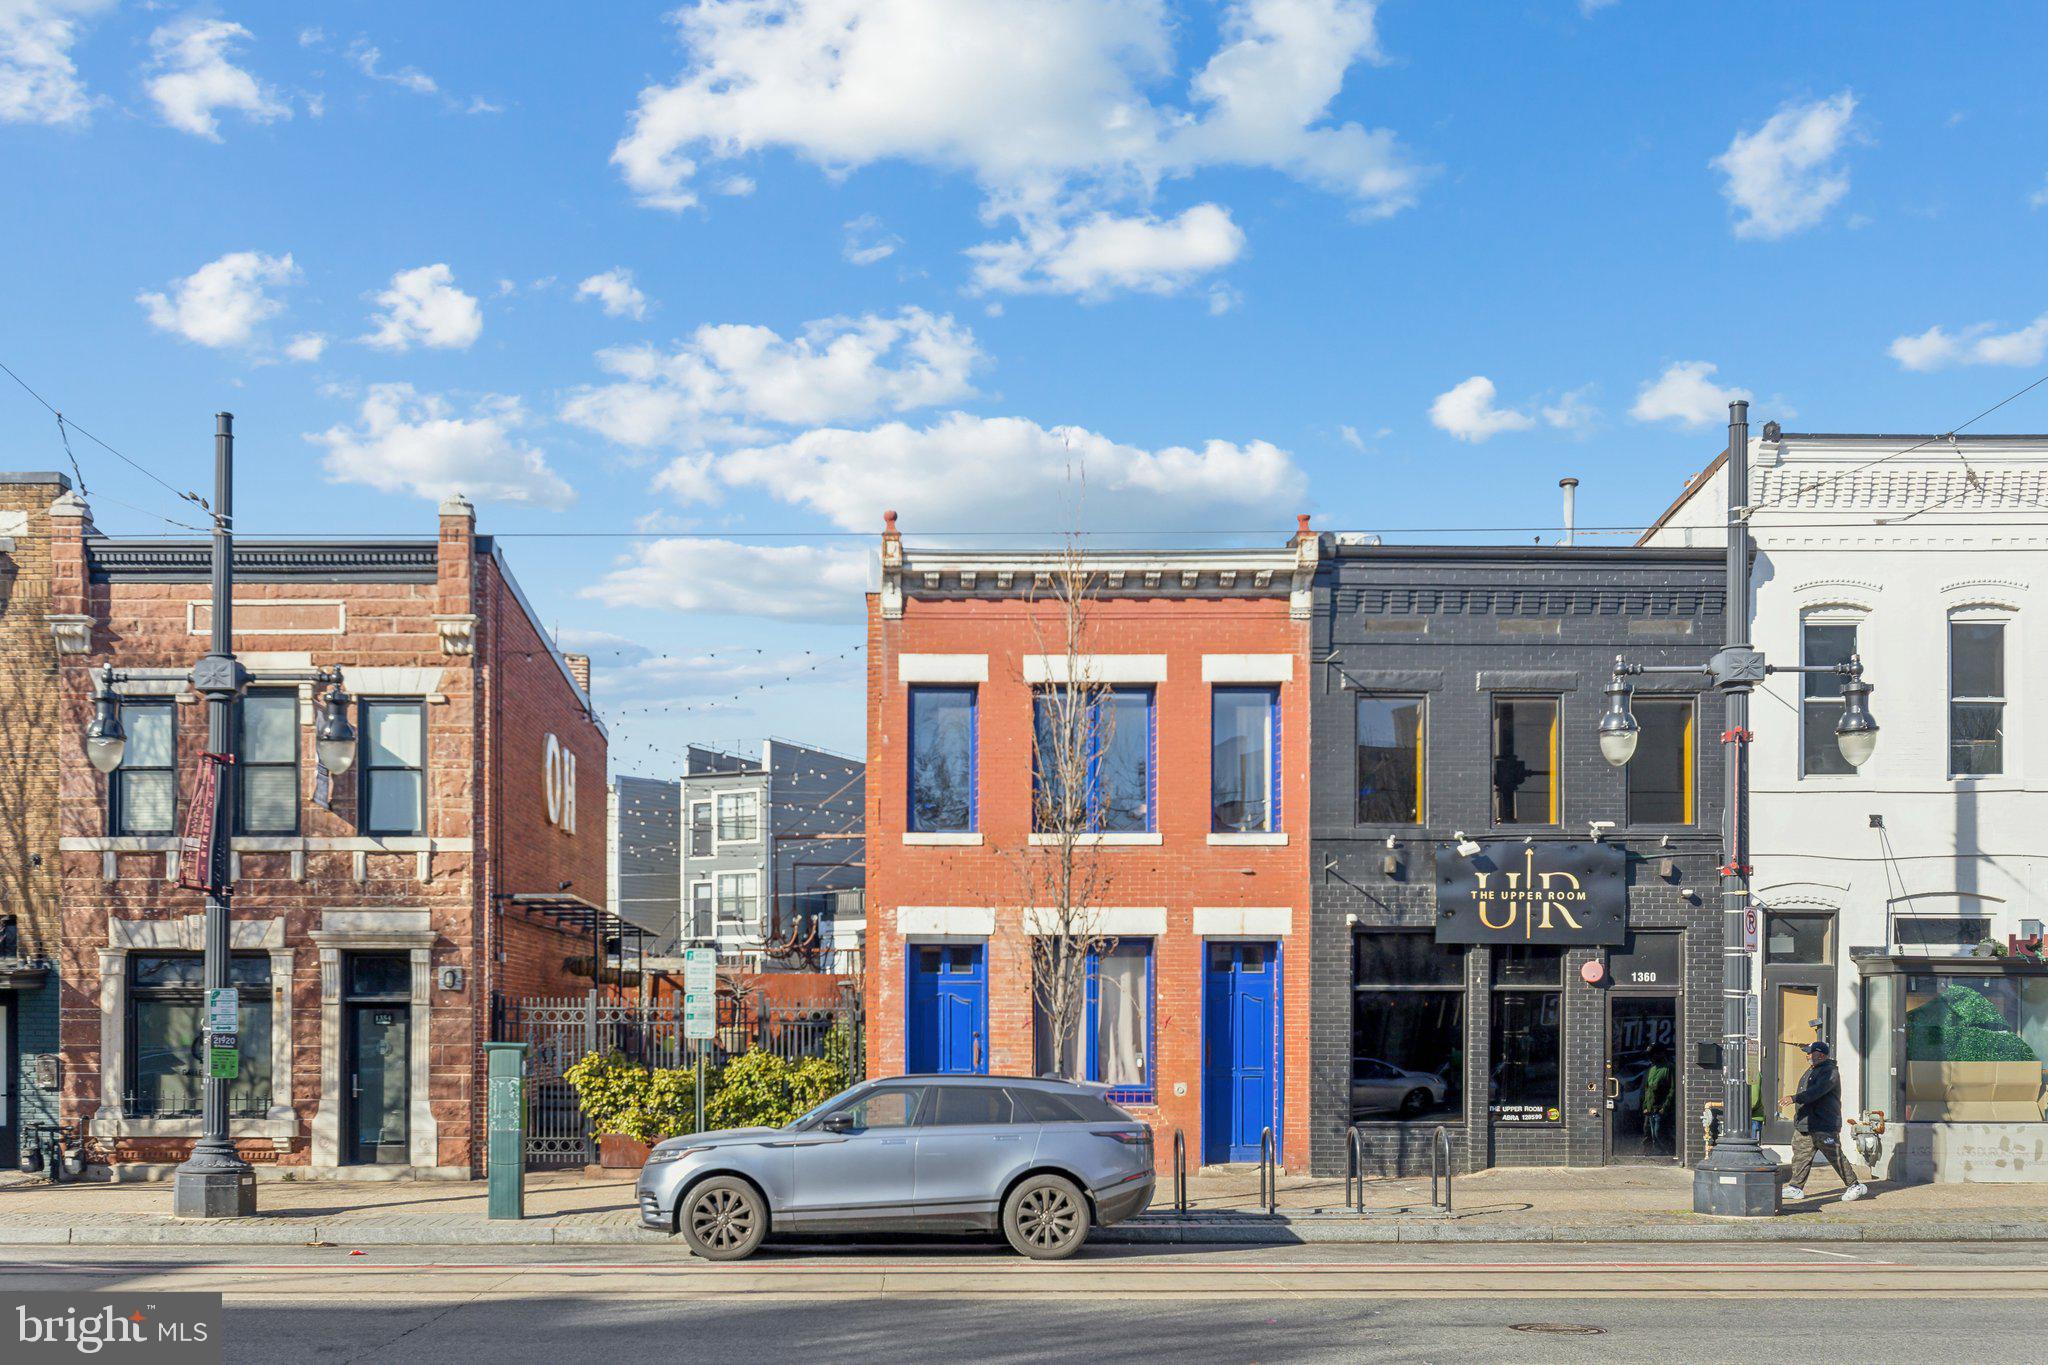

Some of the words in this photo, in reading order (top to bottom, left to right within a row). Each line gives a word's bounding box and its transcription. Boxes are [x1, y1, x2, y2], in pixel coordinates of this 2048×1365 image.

[542, 732, 576, 835] OH
[1471, 891, 1495, 900] THE
[1501, 891, 1542, 900] UPPER
[1548, 891, 1586, 900] ROOM
[1631, 972, 1656, 982] 1360
